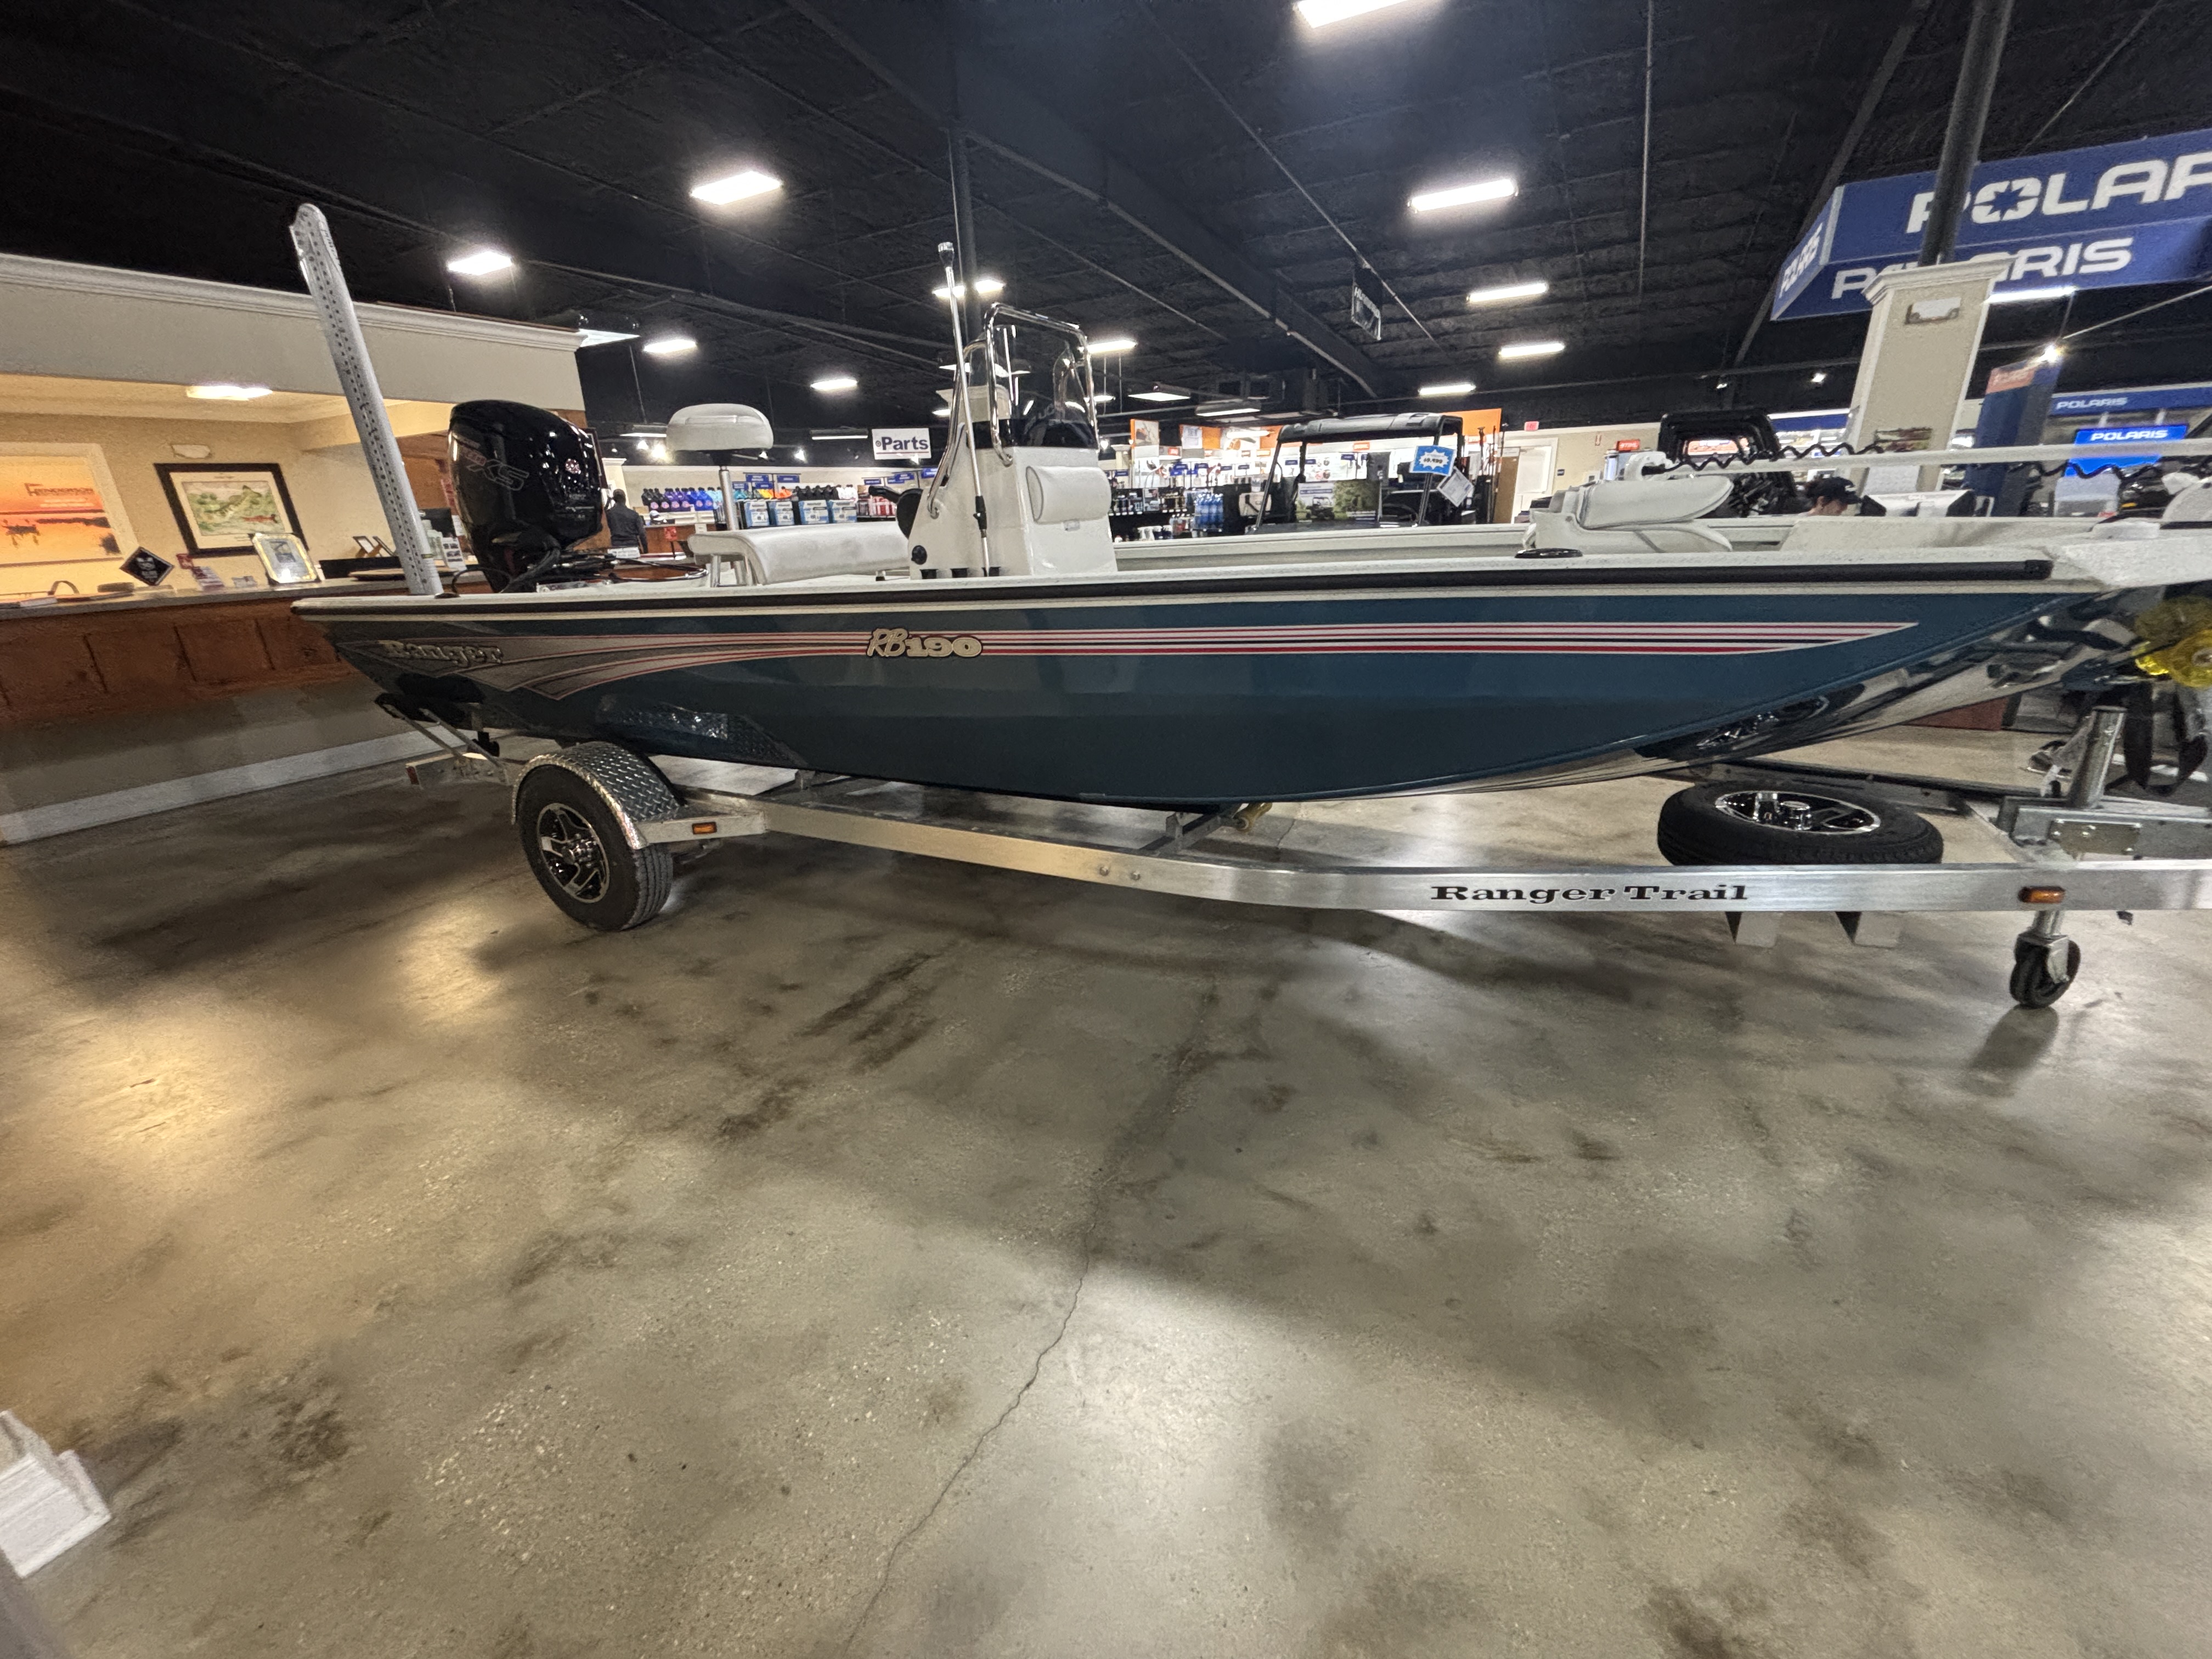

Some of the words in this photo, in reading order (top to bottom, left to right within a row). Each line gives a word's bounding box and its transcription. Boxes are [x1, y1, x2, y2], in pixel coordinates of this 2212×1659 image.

[2056, 397, 2128, 410] POLARIS
[2090, 430, 2169, 441] POLARIS
[882, 436, 929, 450] Parts
[375, 639, 504, 668] Ranger
[1431, 886, 1615, 904] Ranger
[1624, 884, 1748, 900] Trail
